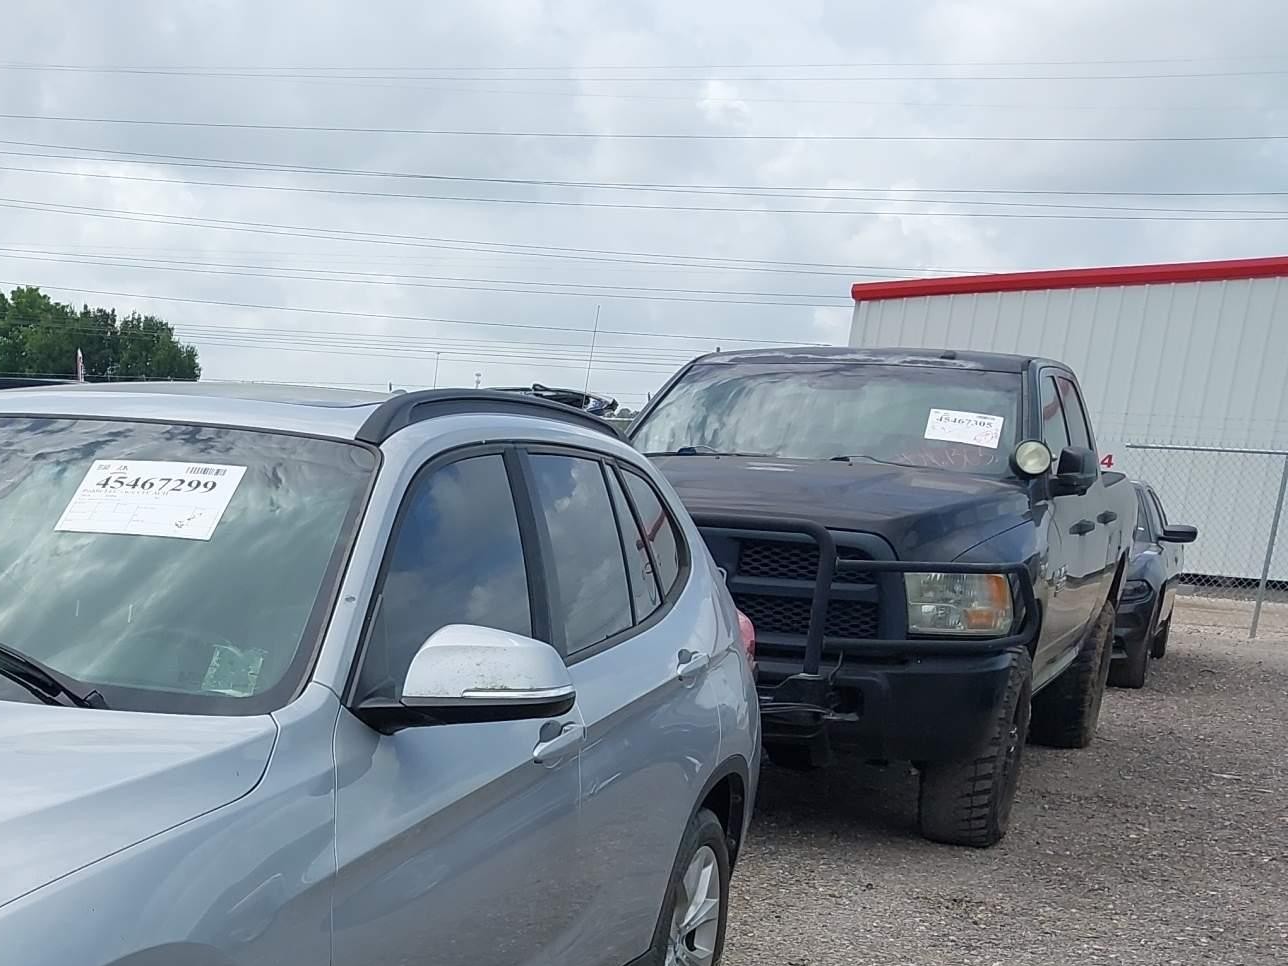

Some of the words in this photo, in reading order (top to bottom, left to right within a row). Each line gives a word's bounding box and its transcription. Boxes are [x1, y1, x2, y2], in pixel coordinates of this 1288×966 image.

[935, 415, 993, 429] 45467305
[1100, 454, 1114, 469] 4
[96, 475, 218, 494] 45467299
